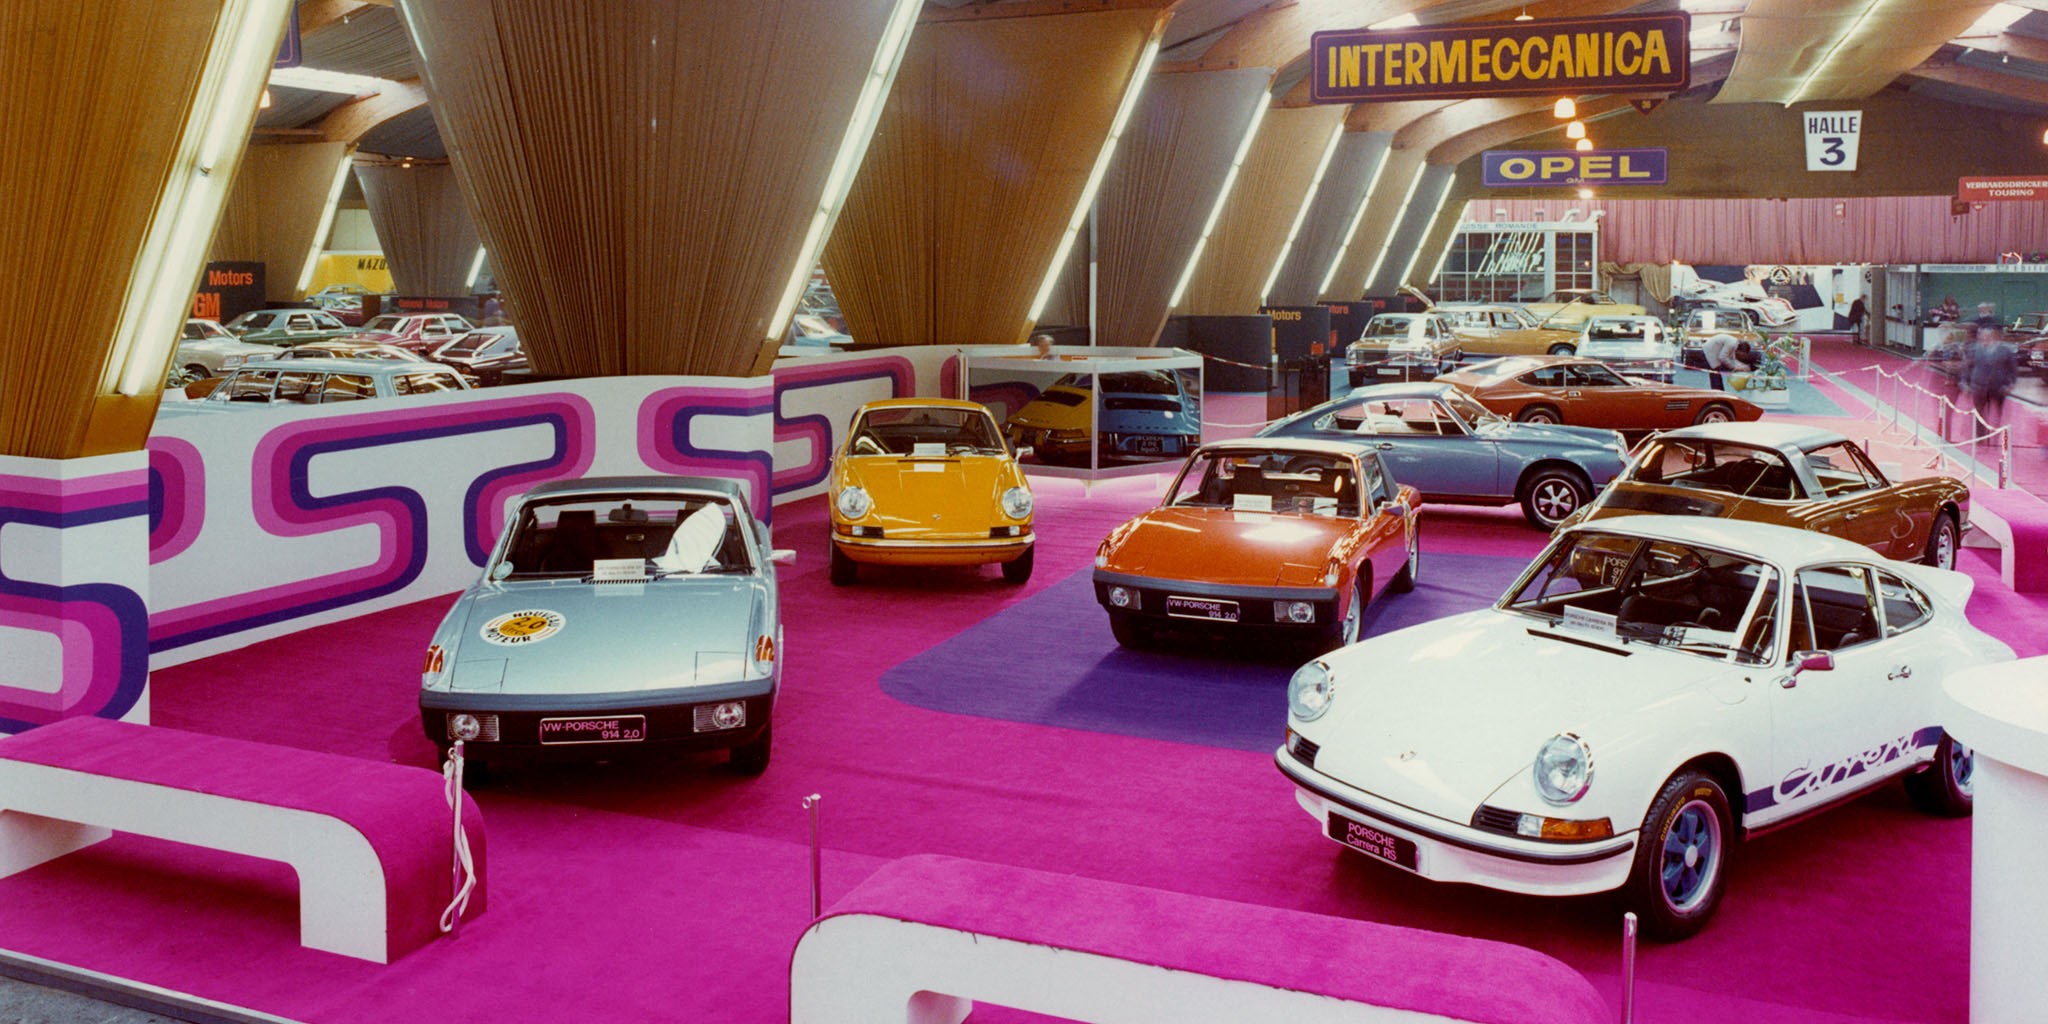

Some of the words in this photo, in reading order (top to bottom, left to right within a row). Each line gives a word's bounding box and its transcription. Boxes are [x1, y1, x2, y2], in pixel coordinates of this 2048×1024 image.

[1328, 30, 1671, 87] INTERMECCANICA
[1809, 116, 1857, 134] HALLE
[1820, 137, 1846, 166] 3
[1500, 156, 1650, 179] OPEL
[208, 270, 253, 286] Motors
[193, 293, 220, 317] GM
[1267, 309, 1301, 321] Motors
[1168, 600, 1221, 611] VW-PORSCHE
[486, 627, 531, 643] MOTEUR
[543, 720, 620, 732] VW-PORSCHE
[602, 730, 620, 739] 914
[1772, 735, 1921, 804] Carrera
[1348, 822, 1395, 849] PORSCHE
[1346, 834, 1380, 854] Carrera
[1383, 847, 1397, 861] RS
